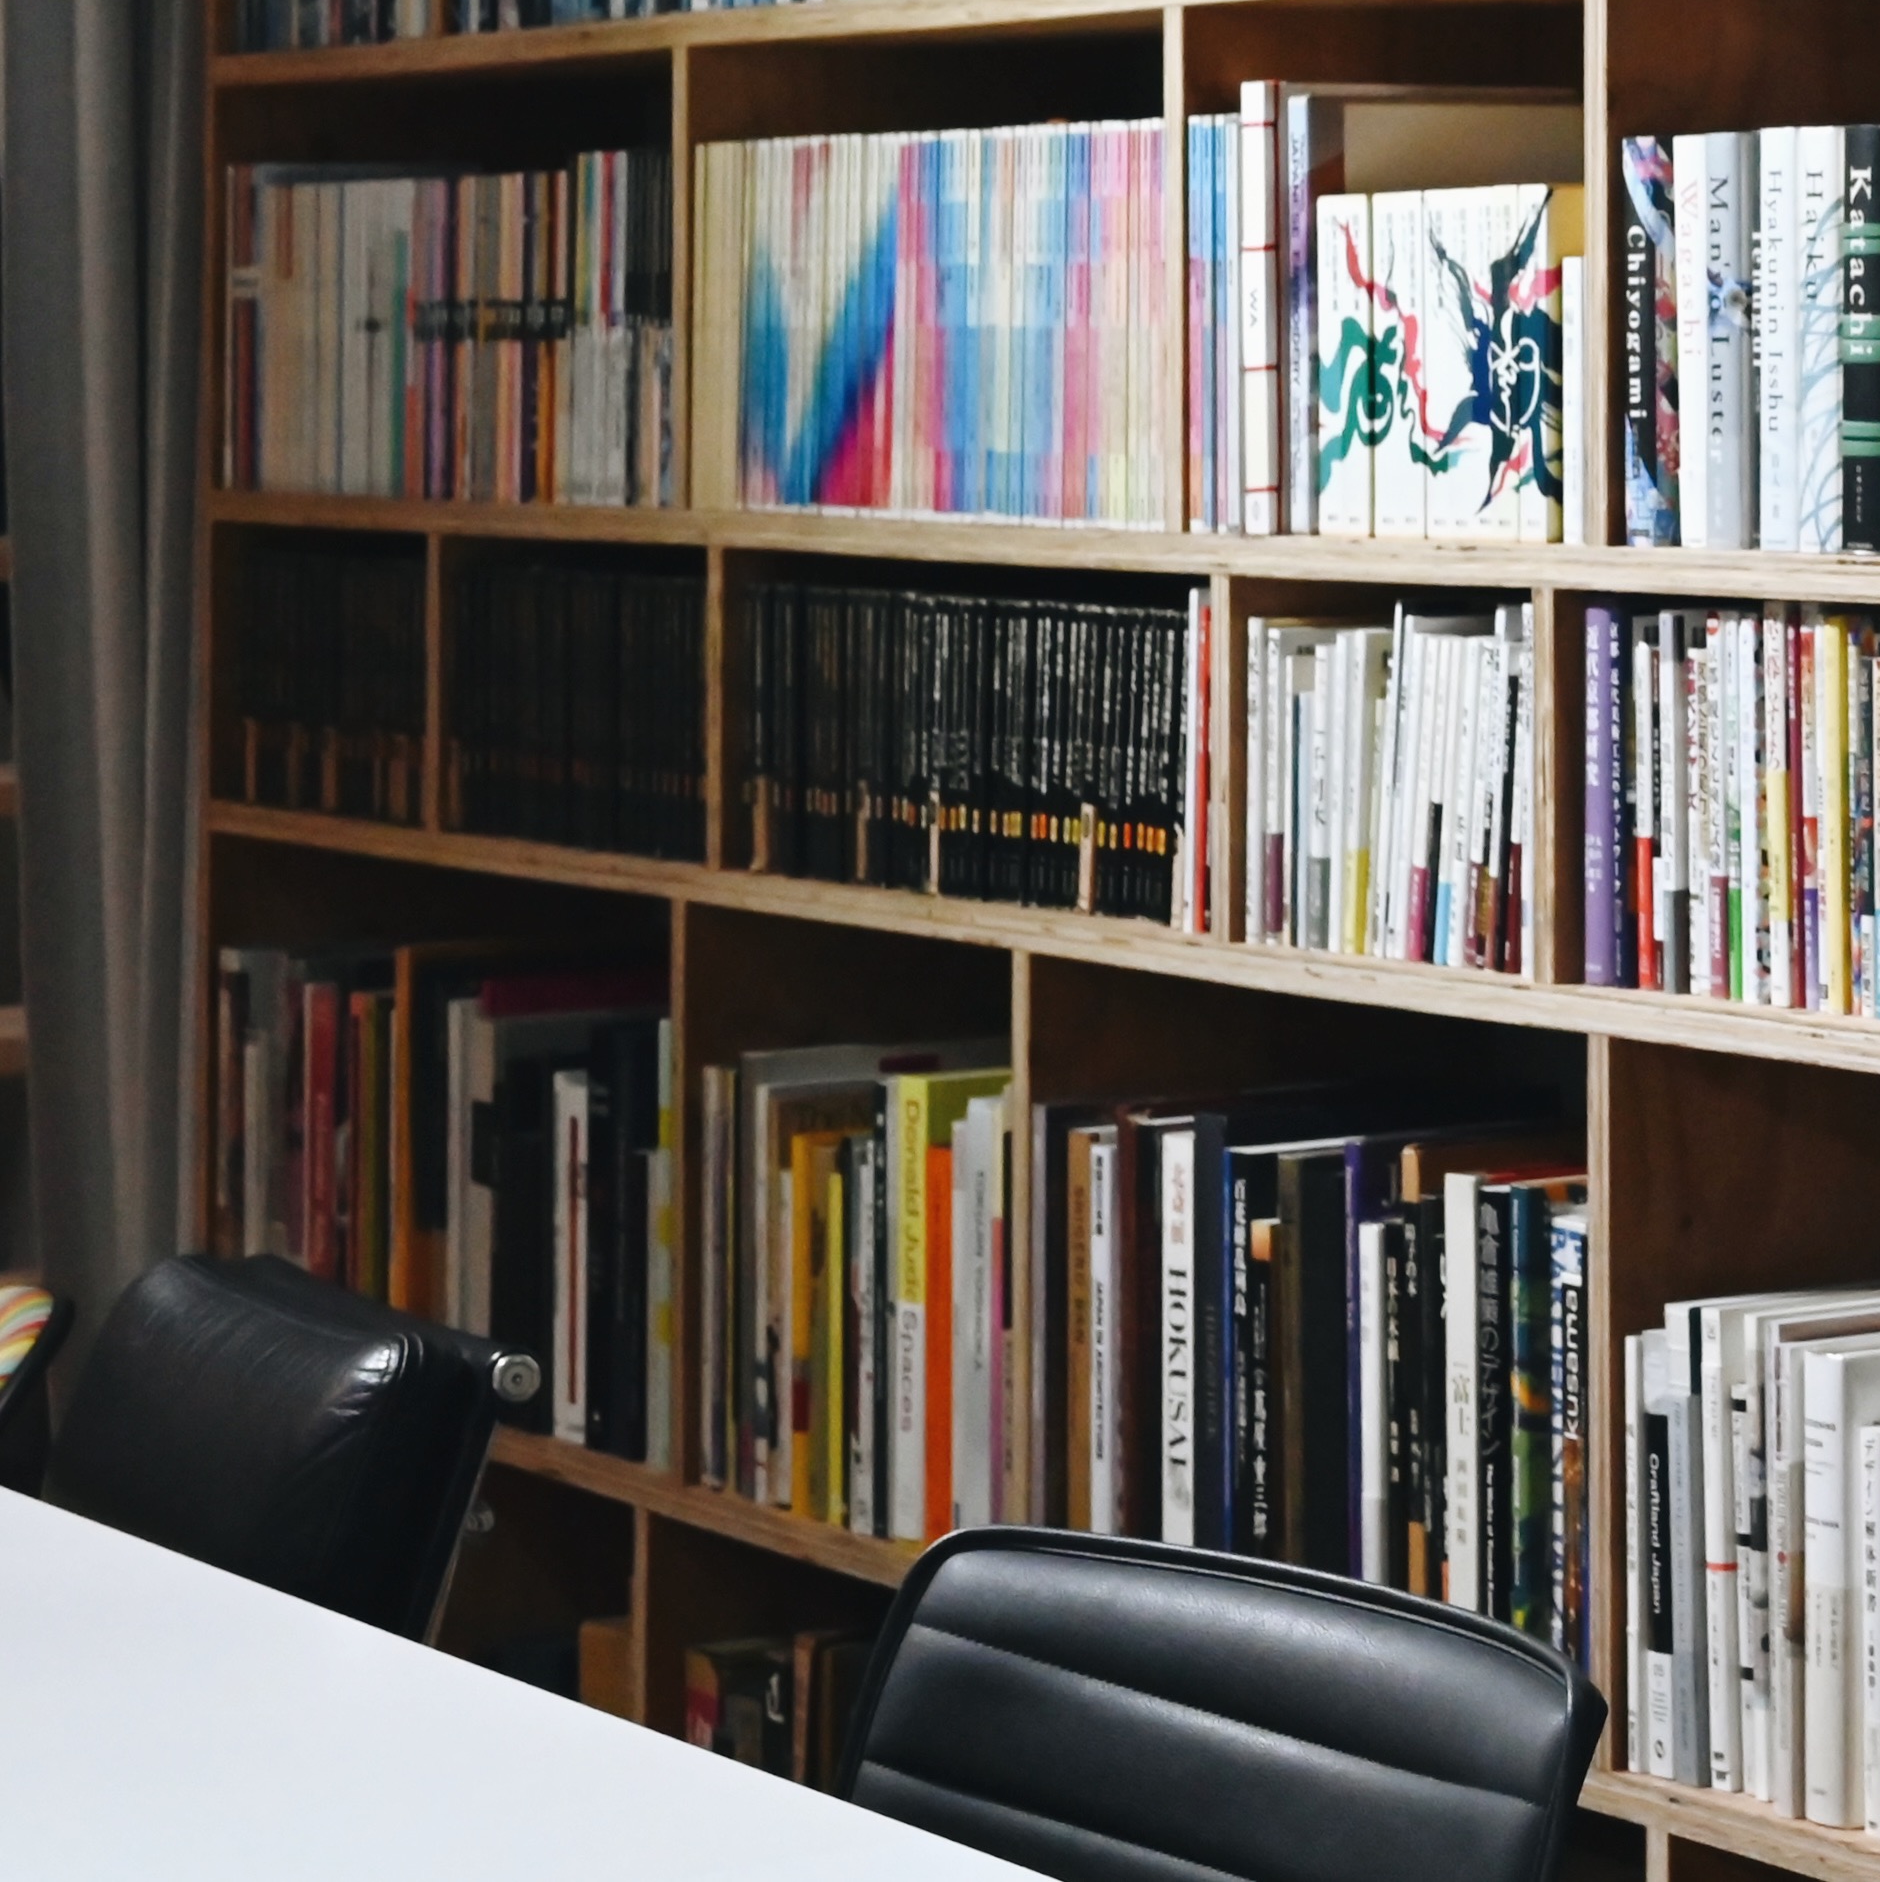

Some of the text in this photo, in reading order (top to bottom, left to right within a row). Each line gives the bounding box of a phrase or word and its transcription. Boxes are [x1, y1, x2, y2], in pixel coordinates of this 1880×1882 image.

[1625, 224, 1648, 420] Chiyogami
[1804, 169, 1824, 302] Haiku
[1849, 165, 1873, 357] Katachi
[1767, 348, 1784, 435] Isshu
[1168, 1267, 1188, 1468] HOKUSAI
[1648, 1453, 1661, 1616] Craftland Japan
